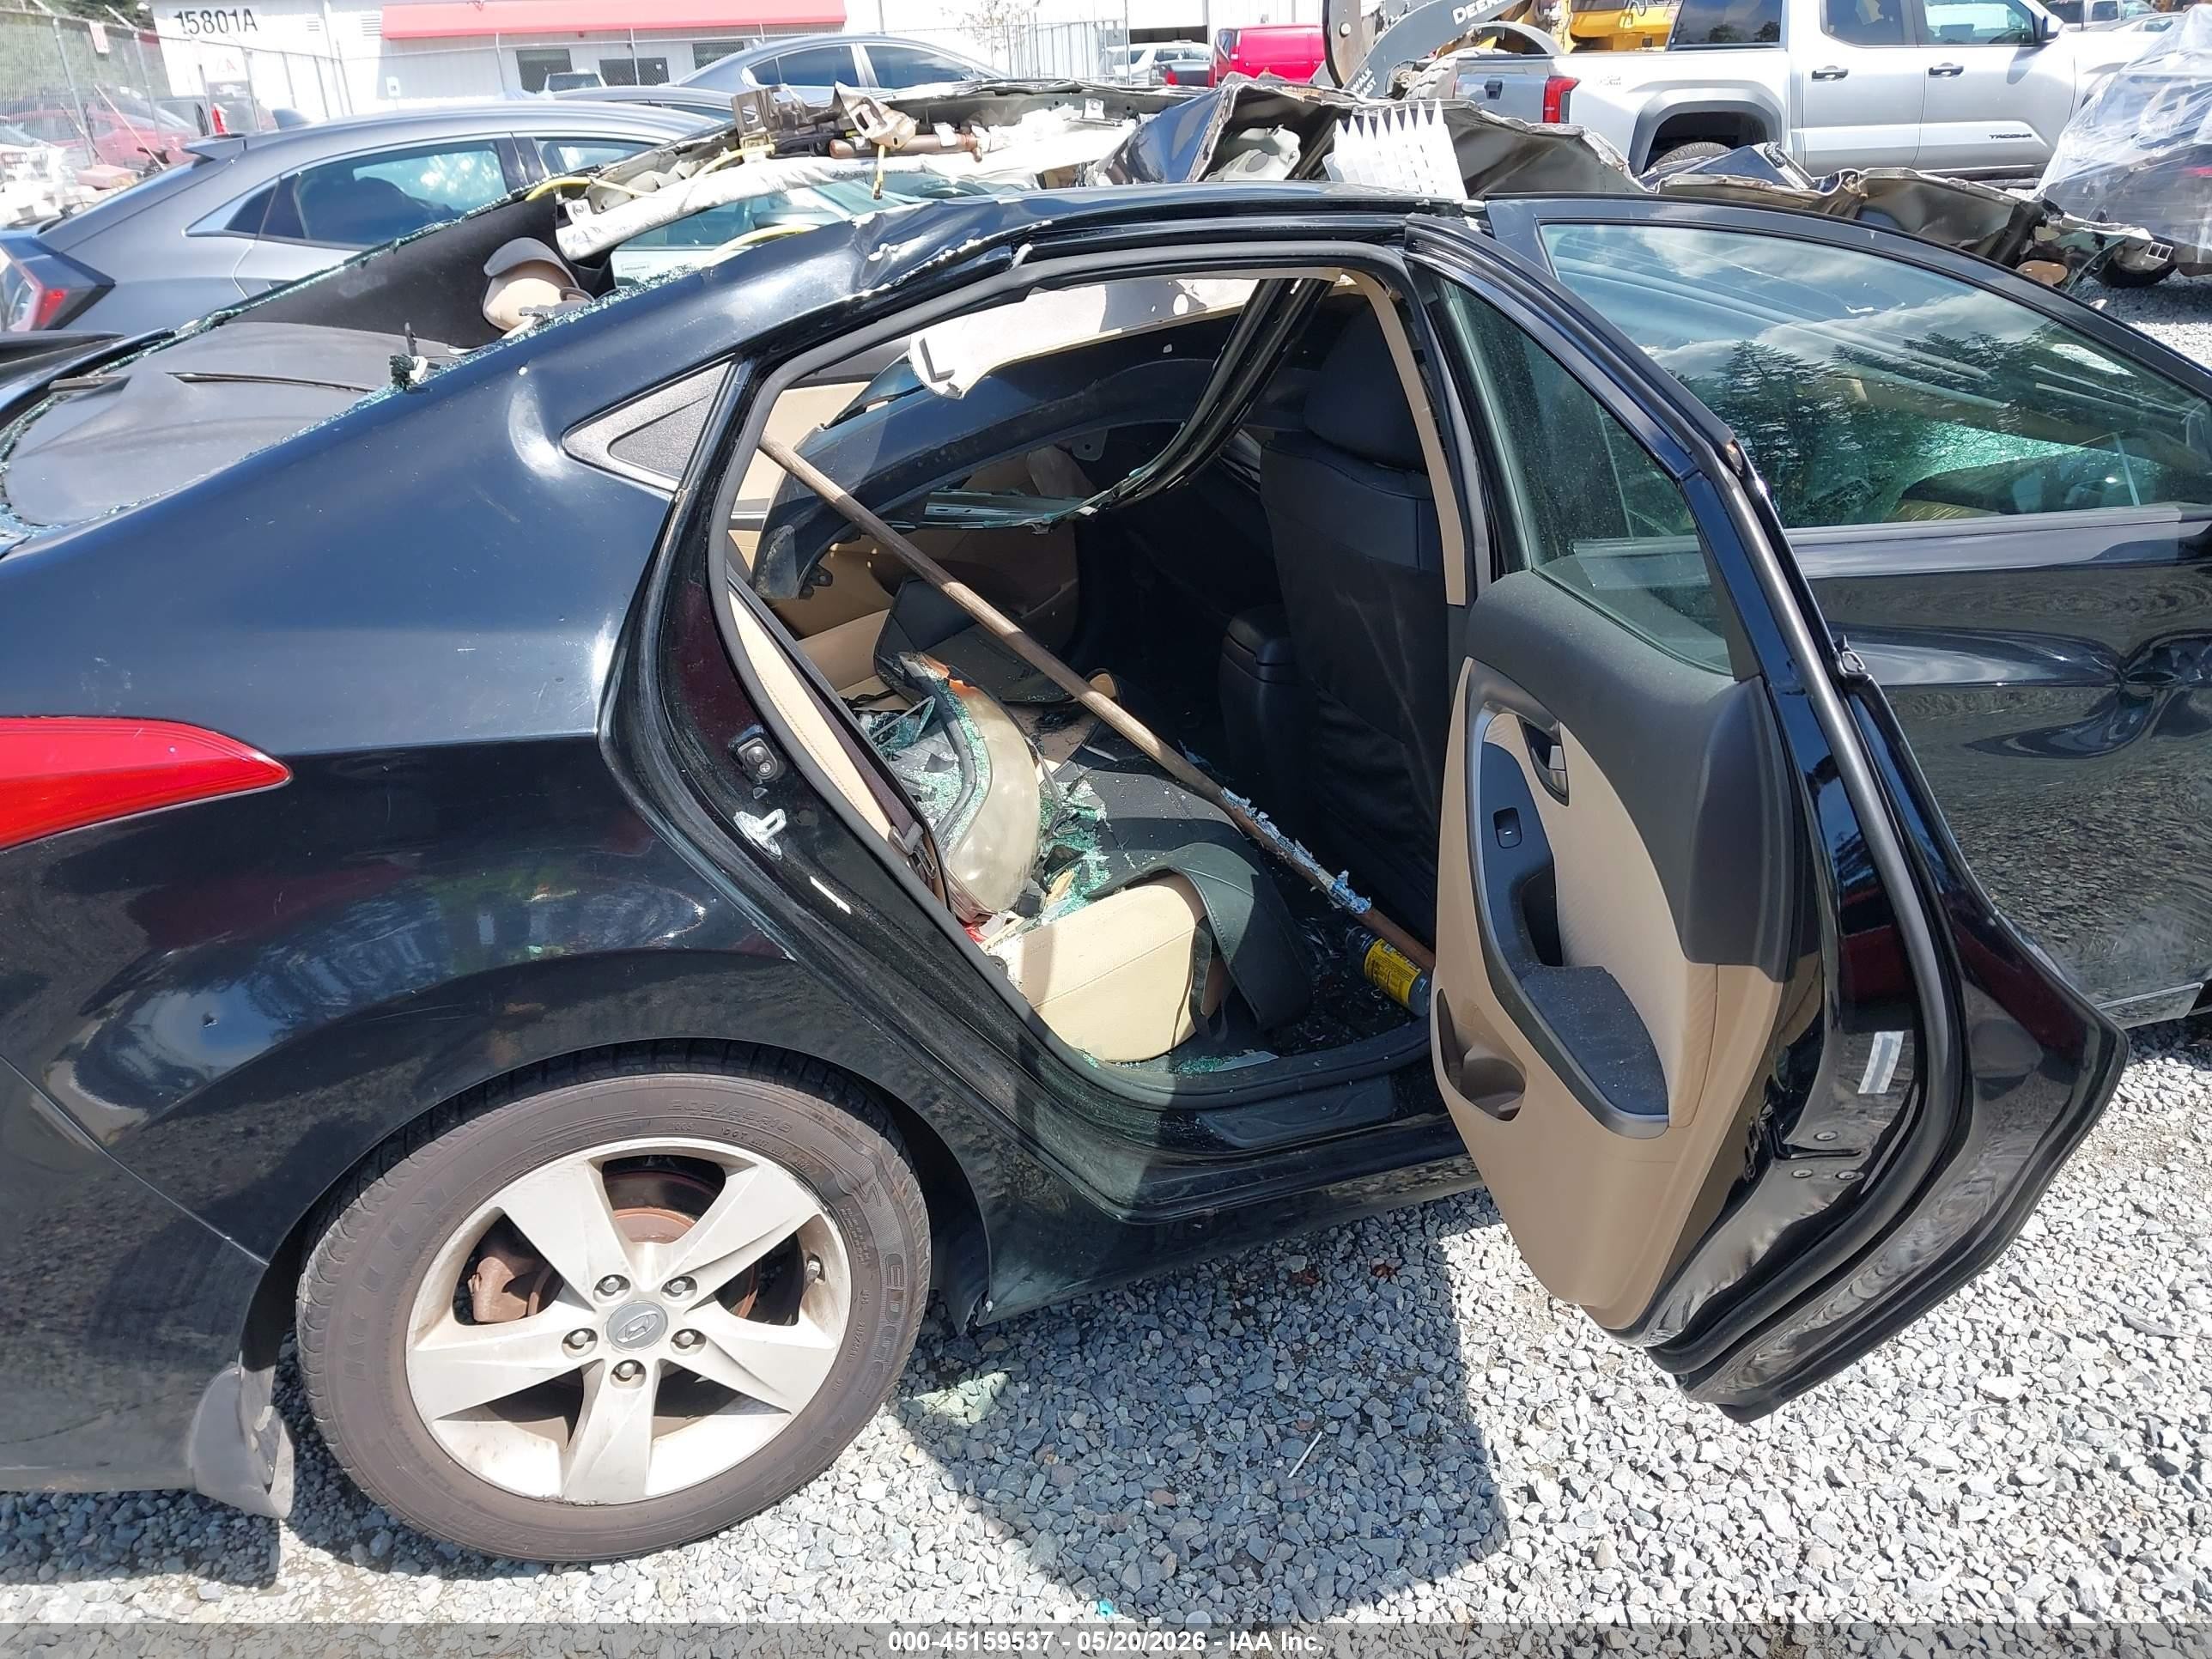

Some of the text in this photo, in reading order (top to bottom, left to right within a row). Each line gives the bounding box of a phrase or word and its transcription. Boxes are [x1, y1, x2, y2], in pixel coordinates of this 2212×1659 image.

[173, 9, 258, 34] 15801A
[1452, 0, 1509, 25] DEER
[1351, 68, 1373, 92] WALK
